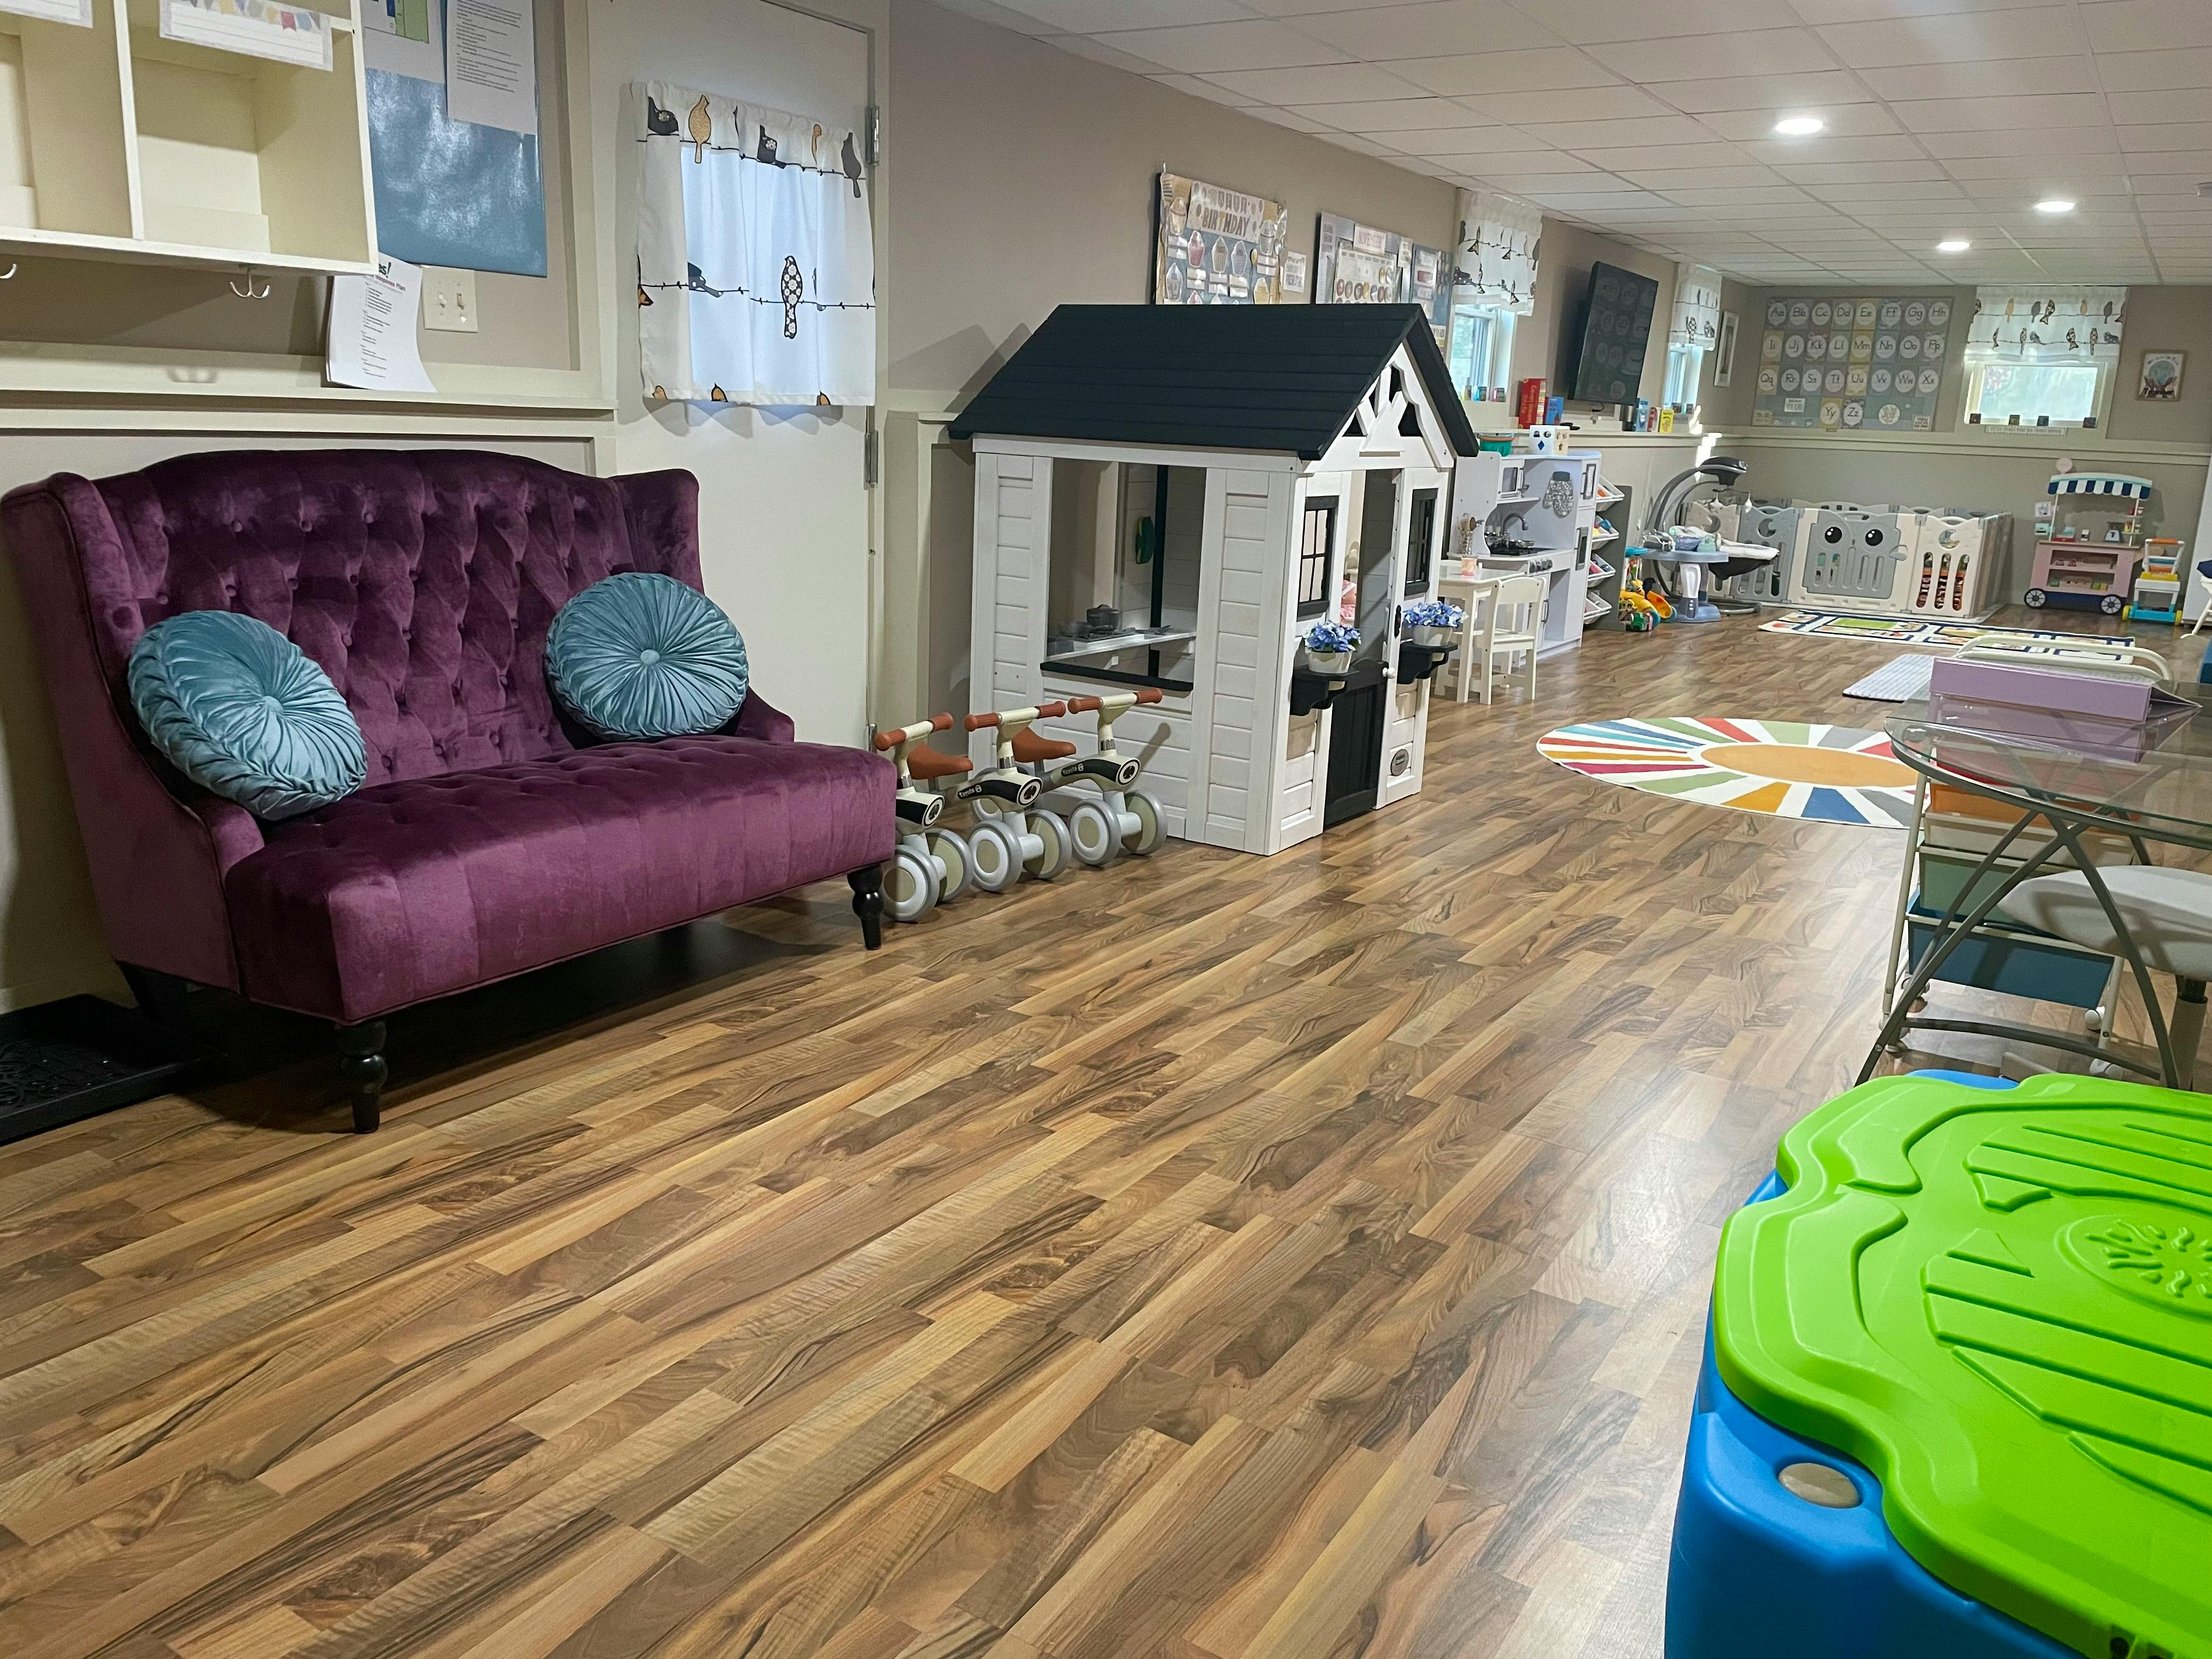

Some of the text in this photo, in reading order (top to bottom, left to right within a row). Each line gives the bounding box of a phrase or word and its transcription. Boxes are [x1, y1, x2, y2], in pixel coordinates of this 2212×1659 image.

[1202, 207, 1250, 237] BIRTHDAY
[1770, 307, 1946, 321] Aa Bb Cc Dd Ee Ff Gg Hh
[1769, 340, 1941, 353] Ii Jj Kk Ll Mm Nn Oo Pp
[1760, 373, 1935, 387] Qq Rr Ss Tt Uu Vv Ww Xx
[1825, 407, 1859, 420] Yy Zz
